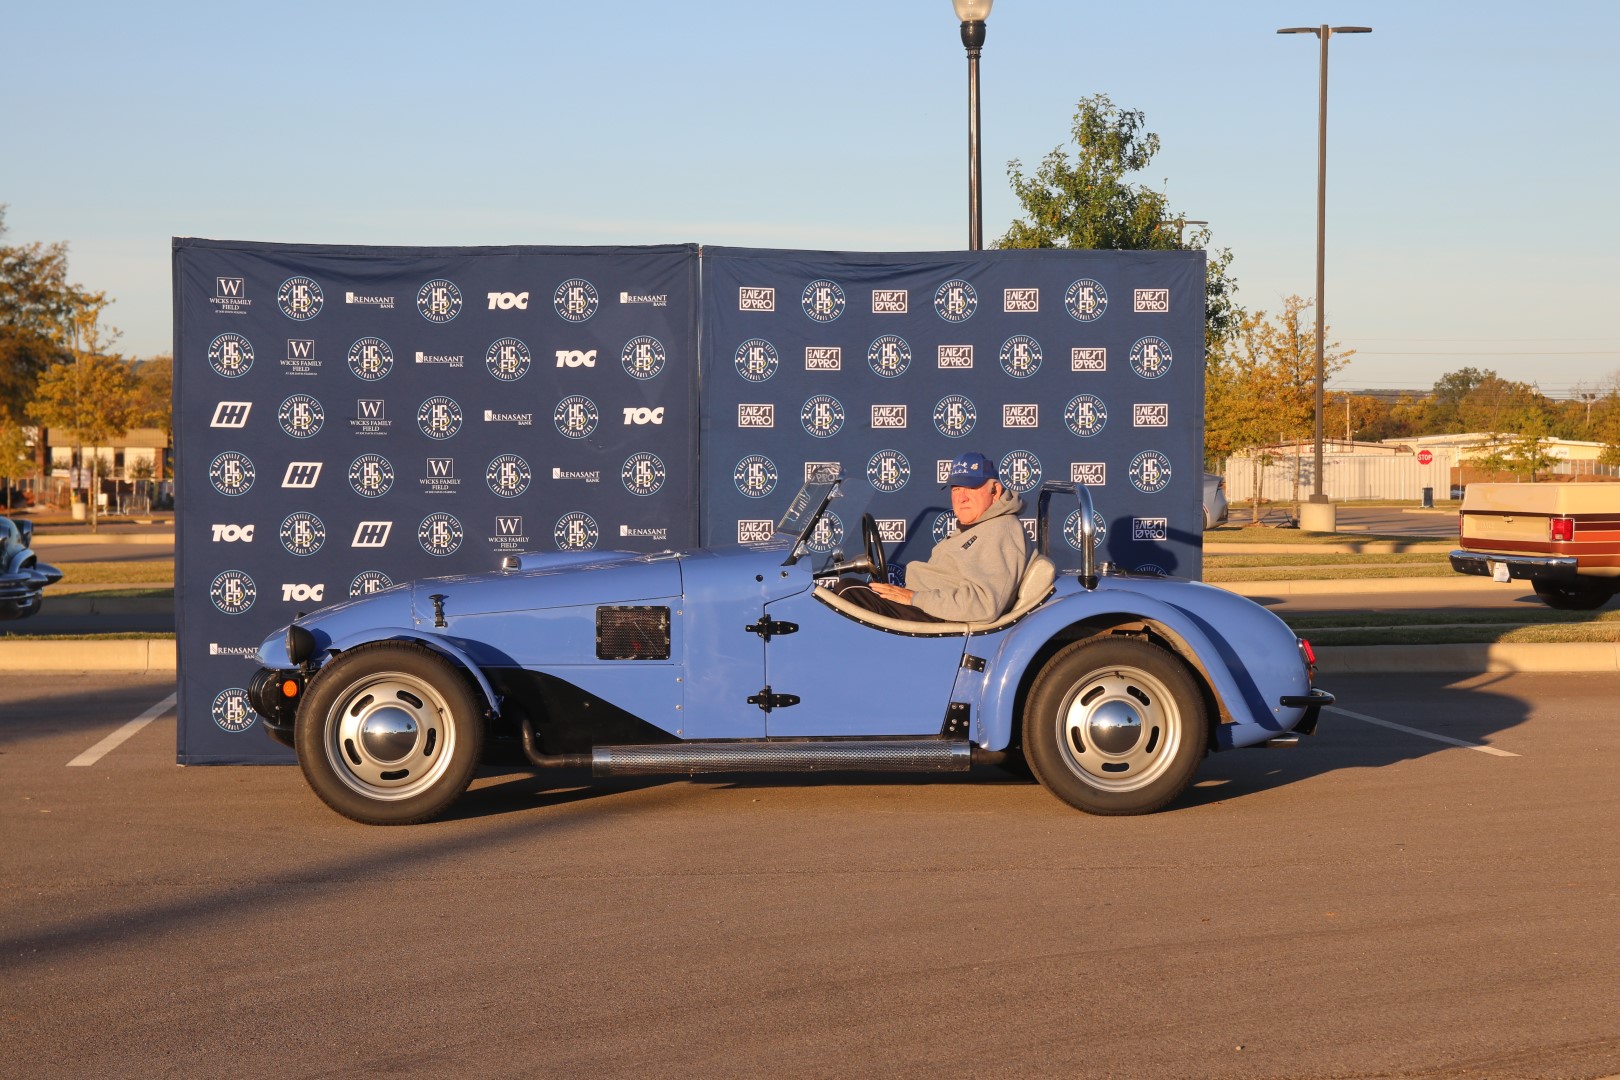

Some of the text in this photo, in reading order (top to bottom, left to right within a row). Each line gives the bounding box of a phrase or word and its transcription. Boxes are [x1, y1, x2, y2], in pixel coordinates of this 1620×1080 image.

[219, 279, 241, 296] W
[292, 285, 308, 298] HC
[568, 287, 583, 300] HC
[816, 287, 831, 300] HC
[948, 287, 963, 300] HC
[1078, 286, 1093, 300] HC
[432, 288, 447, 302] HC
[487, 292, 529, 310] TOC
[746, 290, 772, 299] NEXT
[879, 292, 905, 301] NEXT
[1010, 290, 1036, 300] NEXT
[1141, 290, 1167, 300] NEXT
[752, 299, 772, 309] PRO
[885, 301, 905, 311] PRO
[1016, 300, 1036, 310] PRO
[1147, 300, 1167, 310] PRO
[222, 341, 238, 354] HC
[290, 341, 312, 358] W
[362, 345, 378, 358] HC
[500, 346, 516, 360] HC
[636, 344, 651, 358] HC
[749, 347, 764, 360] HC
[812, 348, 838, 358] NEXT
[881, 342, 896, 356] HC
[945, 346, 971, 356] NEXT
[1013, 343, 1028, 356] HC
[1143, 343, 1158, 356] HC
[555, 350, 597, 368] TOC
[951, 356, 971, 366] PRO
[1078, 350, 1104, 359] NEXT
[818, 358, 838, 368] PRO
[1084, 359, 1104, 369] PRO
[294, 403, 309, 416] HC
[359, 401, 381, 418] W
[432, 404, 447, 418] HC
[568, 403, 583, 416] HC
[623, 406, 665, 424] TOC
[745, 406, 771, 415] NEXT
[815, 402, 830, 416] HC
[878, 406, 904, 416] NEXT
[947, 402, 962, 416] HC
[1010, 406, 1036, 415] NEXT
[1078, 402, 1093, 416] HC
[1140, 406, 1166, 415] NEXT
[751, 415, 771, 425] PRO
[884, 416, 904, 426] PRO
[1016, 415, 1036, 425] PRO
[1146, 415, 1166, 425] PRO
[224, 460, 240, 474] HC
[364, 462, 379, 476] HC
[429, 459, 451, 476] W
[500, 462, 516, 476] HC
[636, 460, 651, 474] HC
[748, 463, 763, 476] HC
[881, 457, 896, 470] HC
[1012, 457, 1027, 470] HC
[1078, 464, 1104, 473] NEXT
[1142, 458, 1157, 472] HC
[1084, 473, 1104, 483] PRO
[294, 520, 310, 534] HC
[432, 521, 448, 534] HC
[497, 518, 519, 534] W
[568, 520, 584, 534] HC
[745, 522, 771, 531] NEXT
[878, 520, 904, 530] NEXT
[1139, 520, 1165, 529] NEXT
[212, 524, 254, 542] TOC
[751, 531, 771, 541] PRO
[884, 530, 904, 540] PRO
[1145, 529, 1165, 539] PRO
[226, 579, 241, 592] HC
[282, 584, 324, 602] TOC
[226, 696, 242, 710] HC
